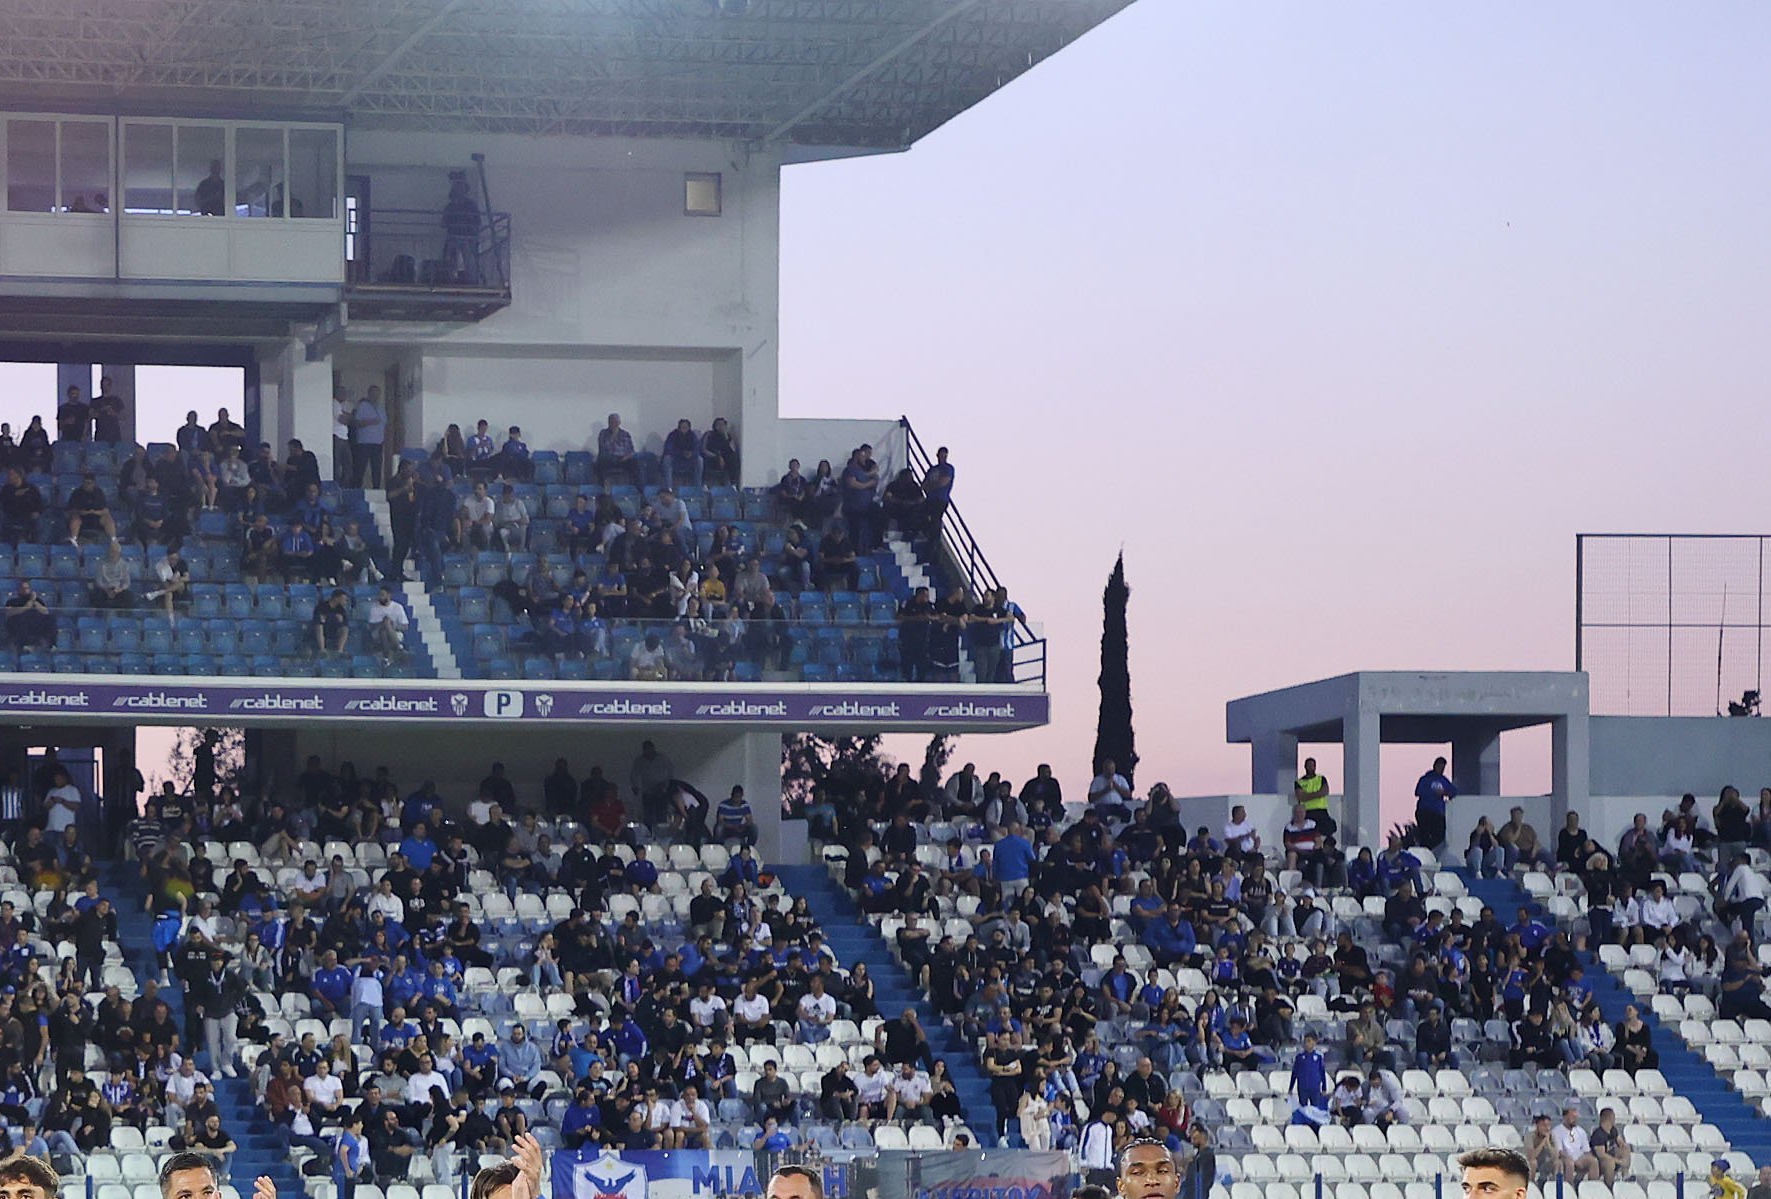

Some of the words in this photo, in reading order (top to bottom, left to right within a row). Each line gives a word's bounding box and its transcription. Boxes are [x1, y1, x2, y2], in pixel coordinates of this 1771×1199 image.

[9, 691, 88, 705] cablenet
[128, 693, 207, 708] cablenet
[244, 694, 323, 709] cablenet
[359, 696, 437, 711] cablenet
[593, 699, 671, 714] cablenet
[710, 700, 786, 715] cablenet
[823, 701, 899, 716] cablenet
[938, 703, 1014, 717] cablenet
